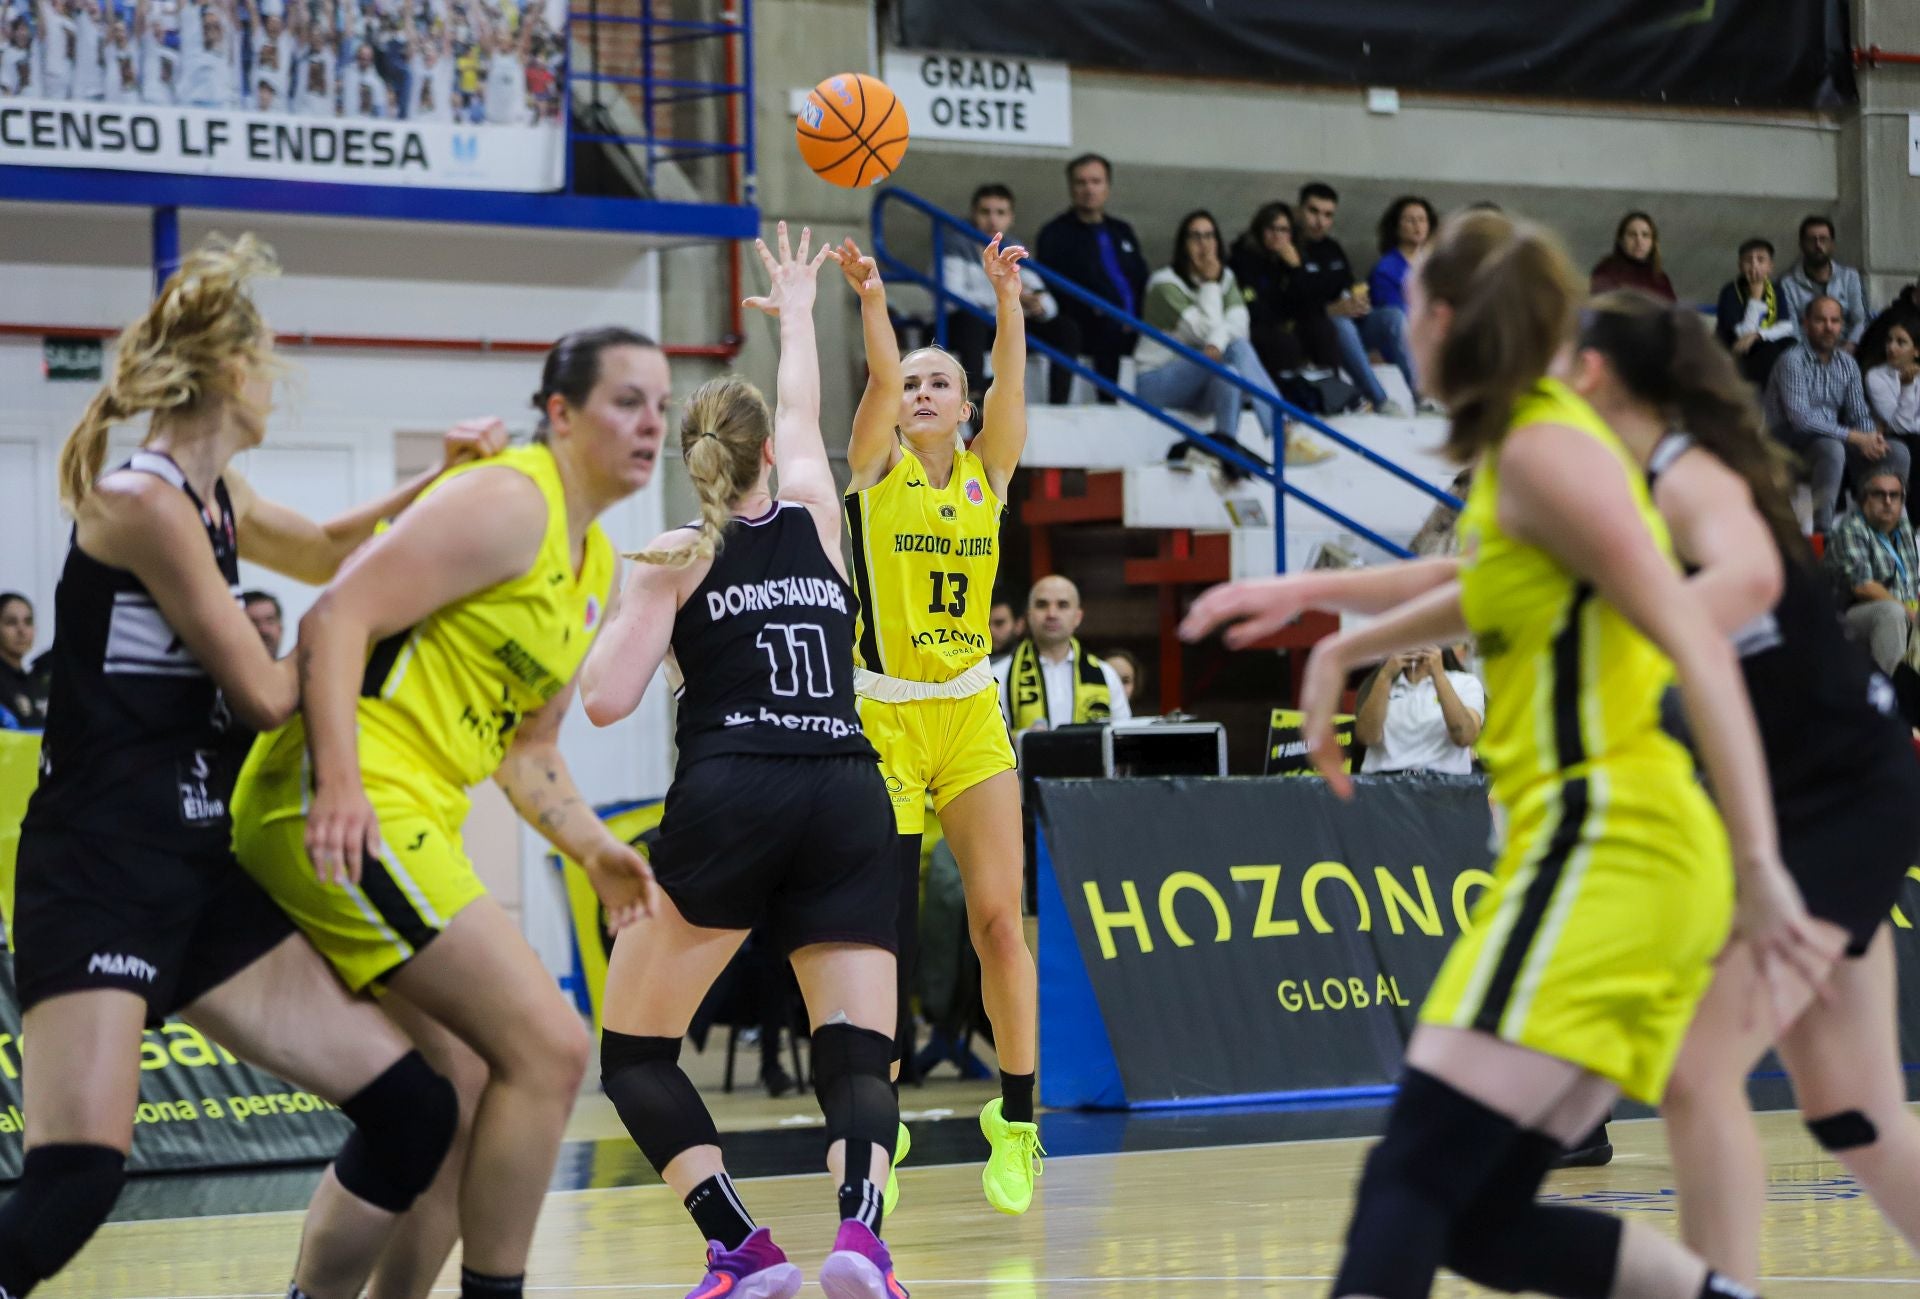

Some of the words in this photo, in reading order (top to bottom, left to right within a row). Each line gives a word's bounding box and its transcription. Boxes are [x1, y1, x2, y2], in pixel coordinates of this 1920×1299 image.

[921, 56, 1034, 93] GRADA
[931, 97, 1027, 131] OESTE
[0, 108, 161, 153] CENSO
[178, 118, 229, 157] LF
[247, 123, 430, 170] ENDESA
[928, 570, 969, 618] 13
[756, 622, 834, 698] 11
[1277, 973, 1411, 1013] GLOBAL
[202, 1098, 225, 1120] a
[227, 1091, 342, 1122] person
